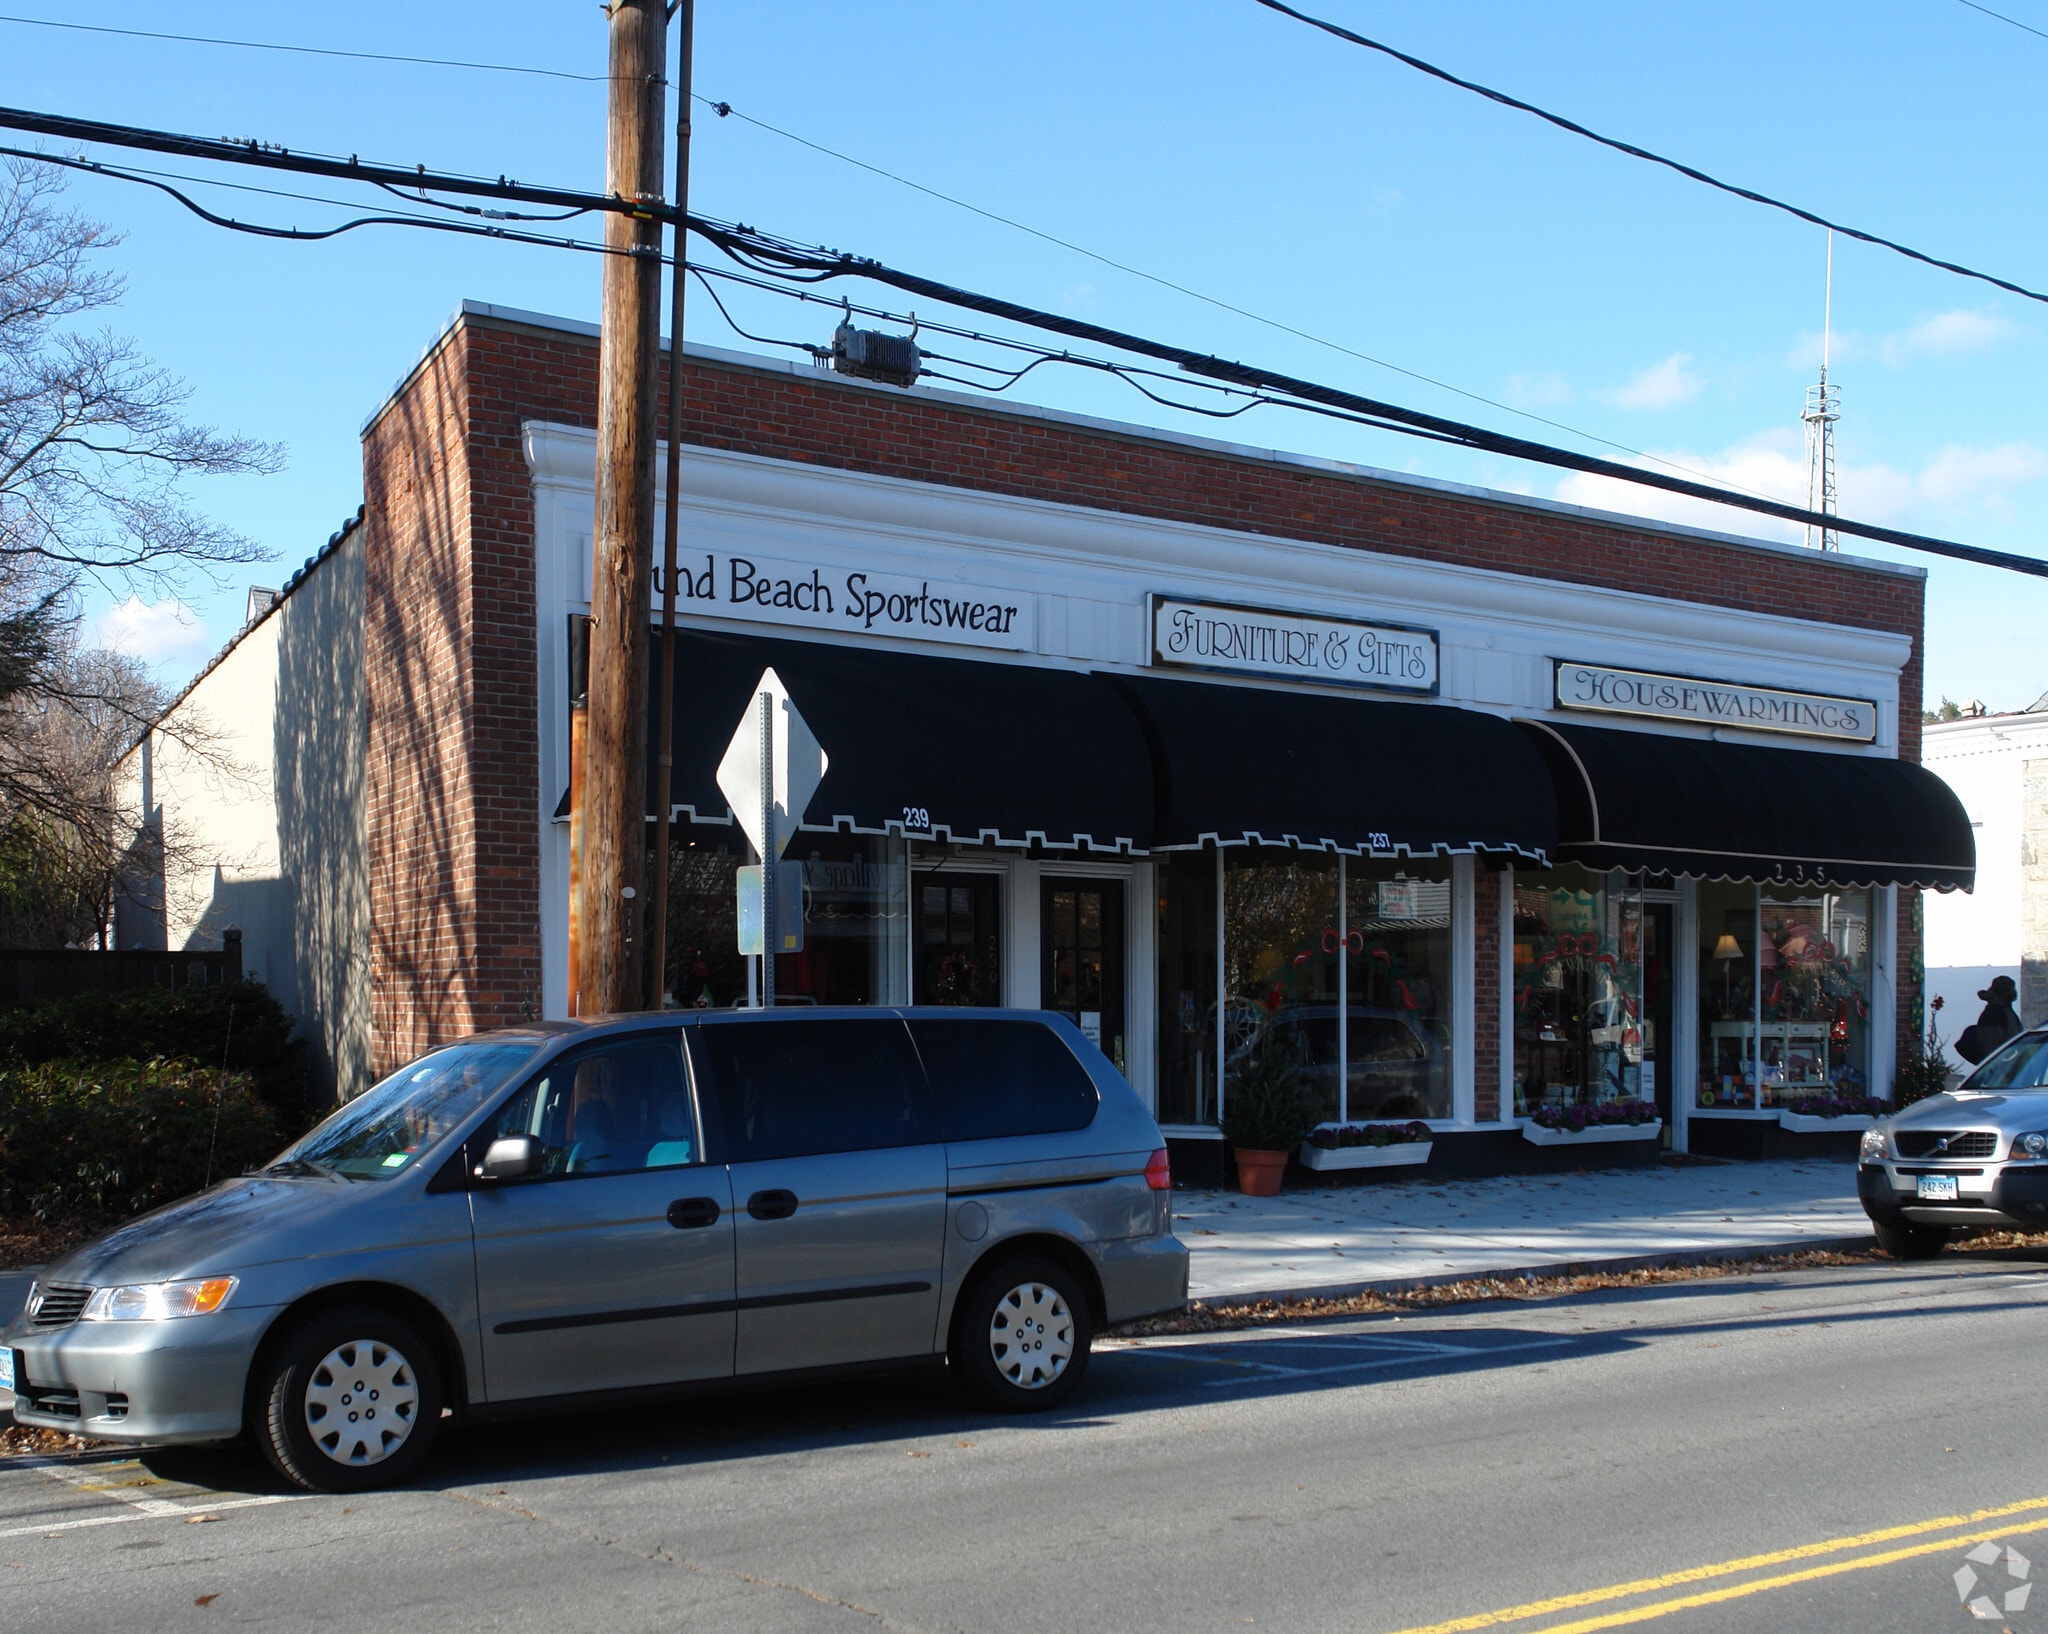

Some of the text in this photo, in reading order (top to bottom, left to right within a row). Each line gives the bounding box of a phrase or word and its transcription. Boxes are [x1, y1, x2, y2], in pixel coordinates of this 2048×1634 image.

[652, 555, 1017, 633] und Beach Sportswear
[1169, 610, 1426, 679] FURNITURE & GIFTS
[1575, 670, 1860, 730] HOUSEWARMINGS
[903, 806, 929, 828] 239
[1368, 832, 1391, 848] 237
[989, 935, 997, 983] 239
